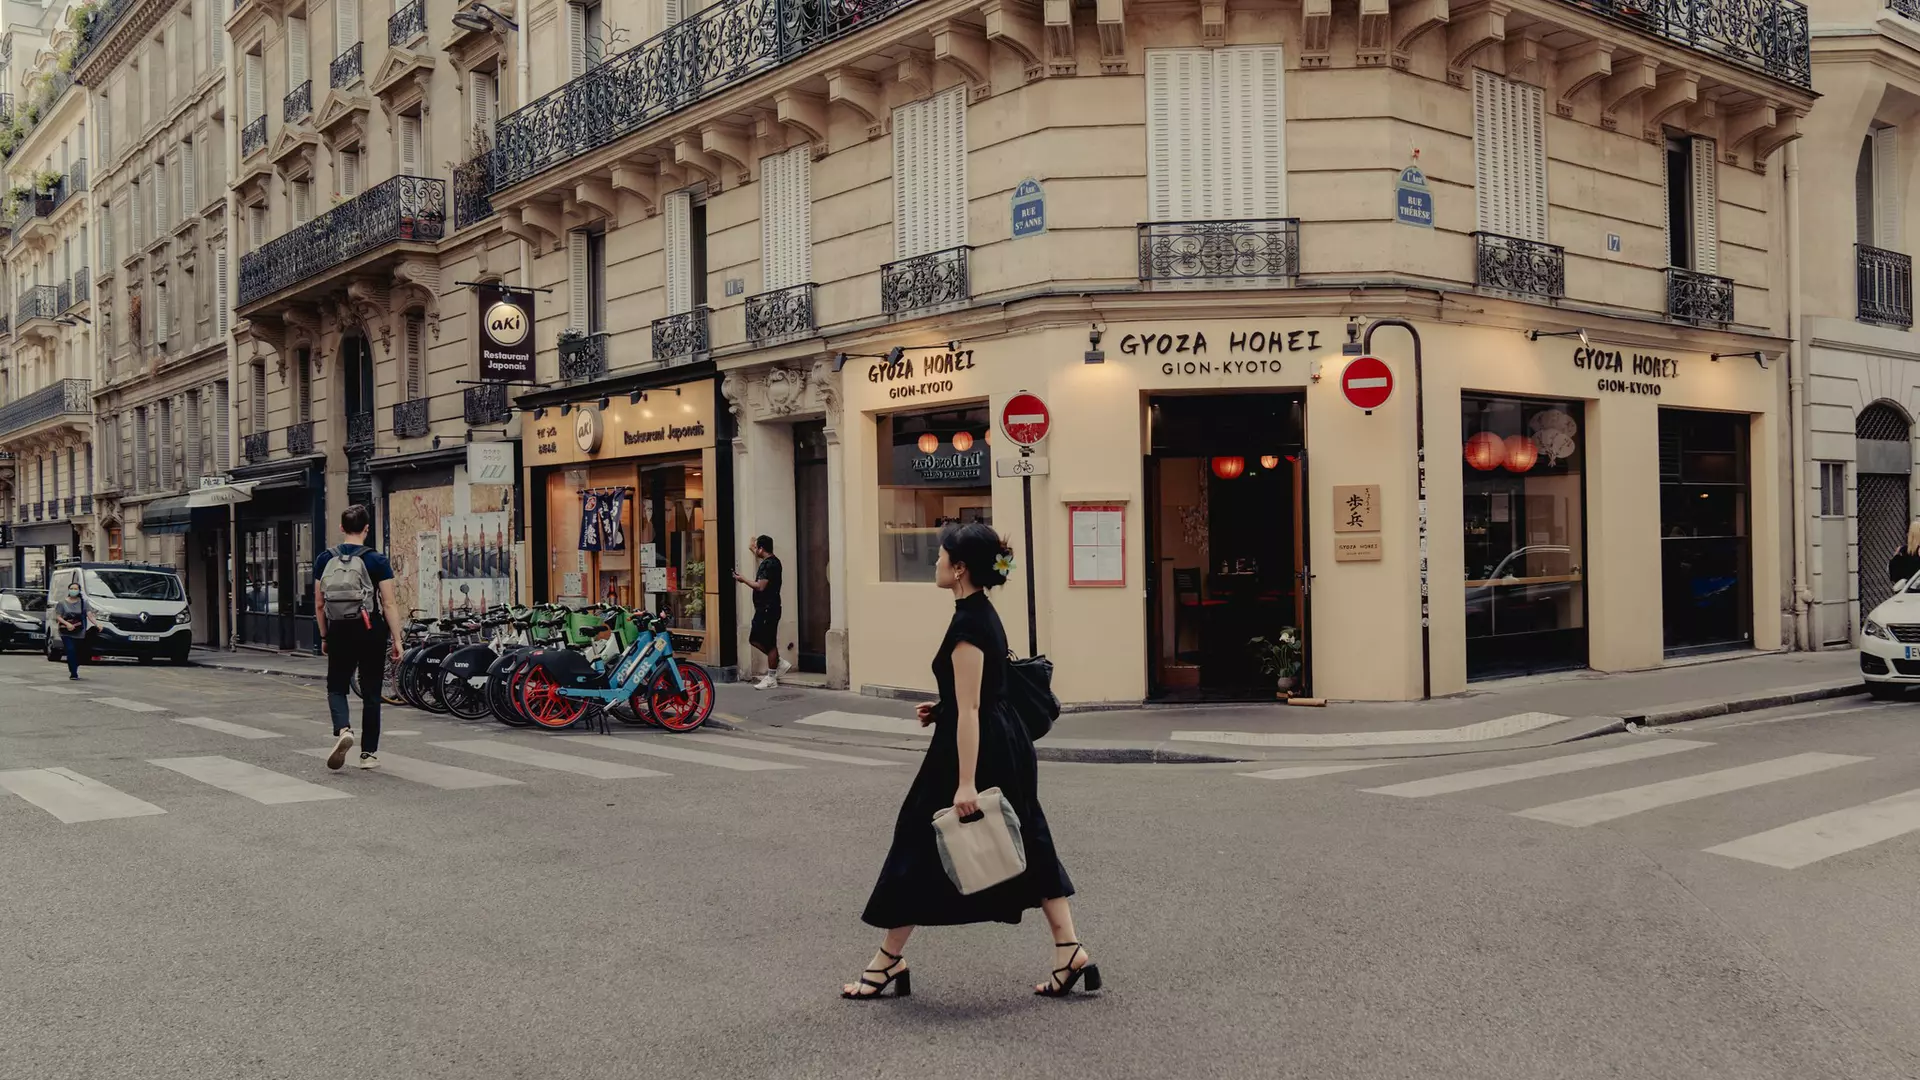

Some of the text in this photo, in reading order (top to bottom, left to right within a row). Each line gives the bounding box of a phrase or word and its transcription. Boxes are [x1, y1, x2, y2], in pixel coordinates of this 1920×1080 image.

[1407, 196, 1423, 207] RUE
[1021, 206, 1036, 218] RUE
[1400, 205, 1431, 220] THÉRÈSE
[1024, 216, 1043, 229] ANNE
[1608, 234, 1619, 250] 17
[1120, 330, 1323, 355] GYOZA HOHEI
[483, 350, 530, 361] Restaurant
[1573, 347, 1681, 379] GYOZA HOHEI
[487, 360, 527, 372] Japonais
[868, 349, 976, 384] GYOZA HOHEI
[1161, 359, 1282, 376] GION-KYOTO
[889, 379, 953, 400] GION-KYOTO
[1597, 379, 1662, 396] GION-KYOTO
[624, 420, 705, 446] Restaurant Japonais
[1346, 494, 1364, 527] 歩兵
[633, 660, 652, 684] dott
